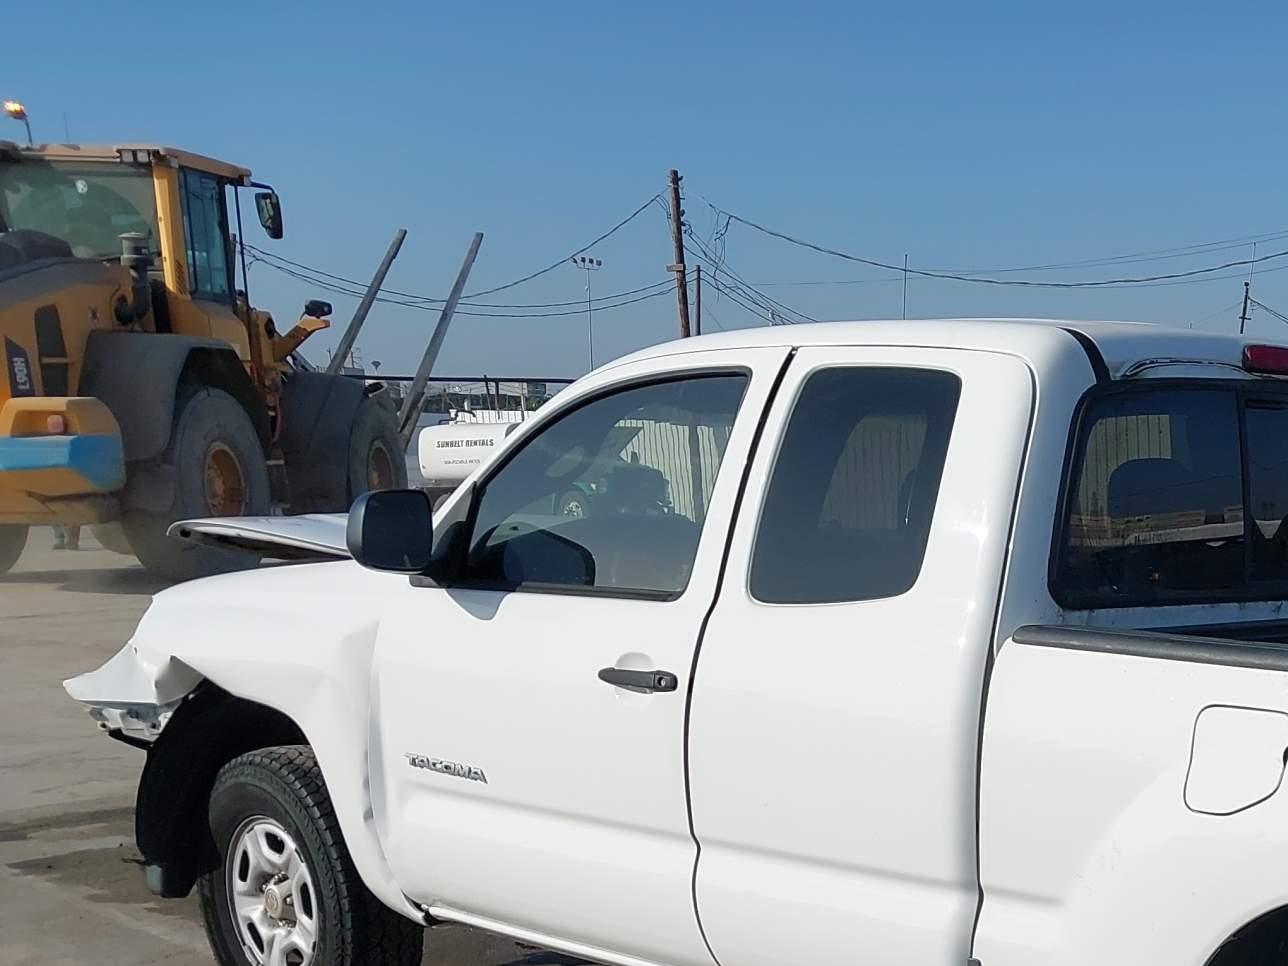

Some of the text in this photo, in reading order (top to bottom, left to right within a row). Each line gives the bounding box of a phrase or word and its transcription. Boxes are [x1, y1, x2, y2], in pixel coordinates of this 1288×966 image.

[12, 357, 30, 389] L90H
[436, 439, 494, 448] SUNBELT RENTALS
[404, 752, 488, 784] TACOMA
